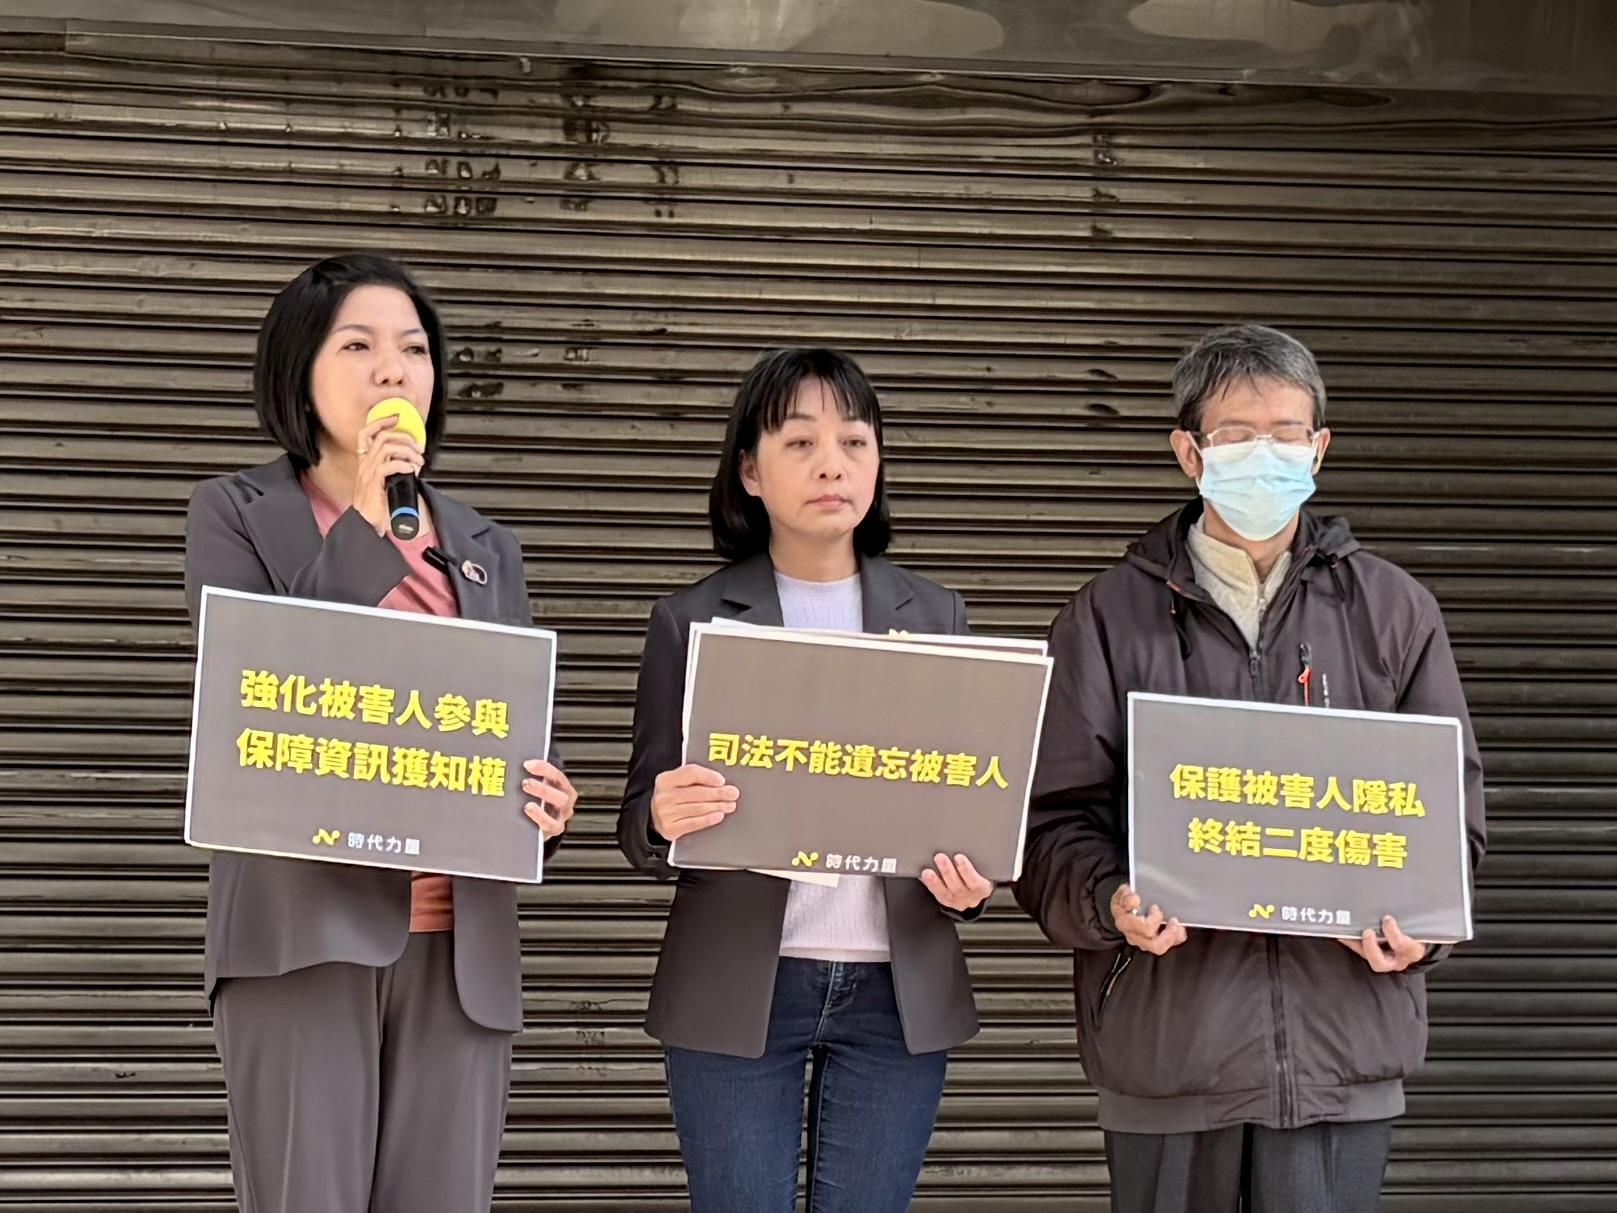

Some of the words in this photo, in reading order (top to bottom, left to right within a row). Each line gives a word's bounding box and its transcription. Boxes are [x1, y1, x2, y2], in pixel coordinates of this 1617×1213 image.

[241, 671, 509, 738] 強化被害人參與
[237, 729, 507, 796] 保障資訊獲知權
[709, 732, 1009, 789] 司法不能遺忘被害人
[1170, 764, 1425, 817] 保護被害人隱私
[1188, 819, 1407, 868] 終結二度傷害
